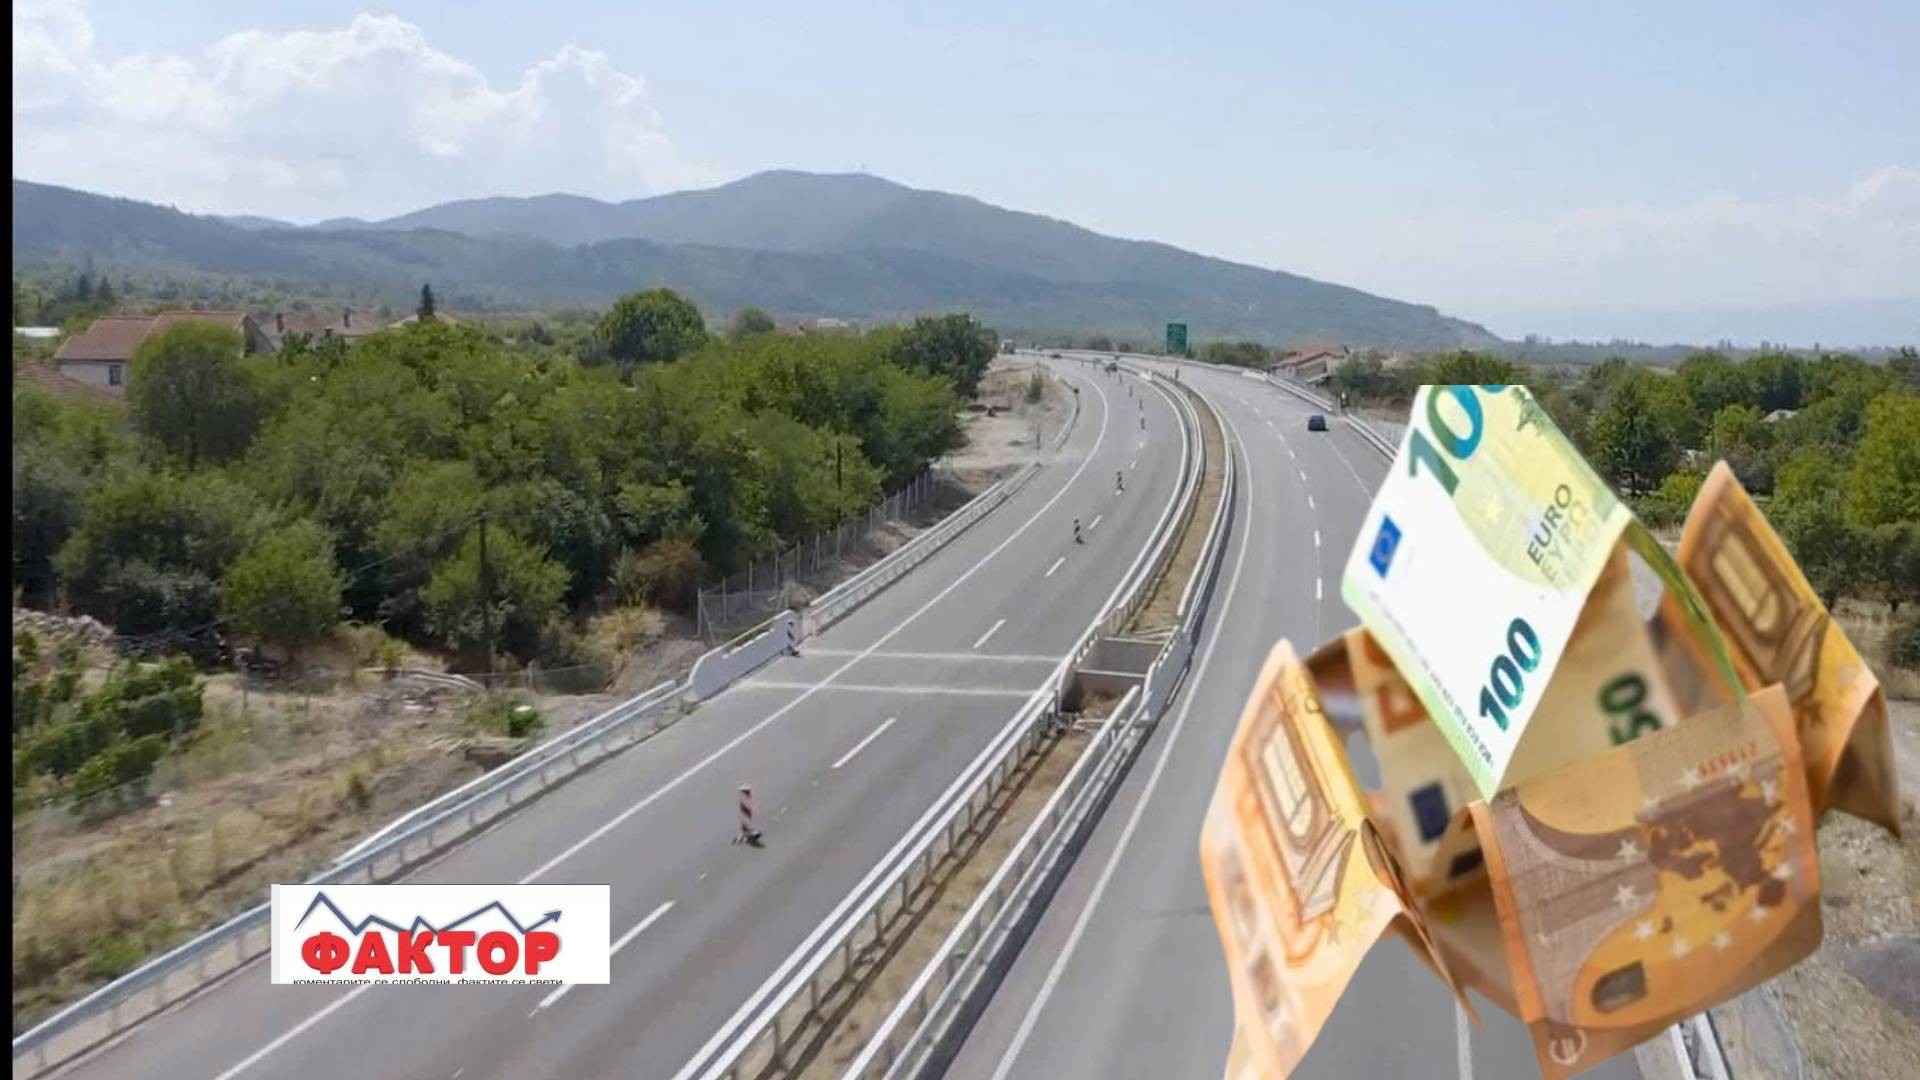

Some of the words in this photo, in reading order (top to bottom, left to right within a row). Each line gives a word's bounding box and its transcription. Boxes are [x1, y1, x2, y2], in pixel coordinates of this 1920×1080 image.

[1408, 385, 1508, 498] 10
[1527, 483, 1572, 566] EURO
[1479, 617, 1542, 732] 100
